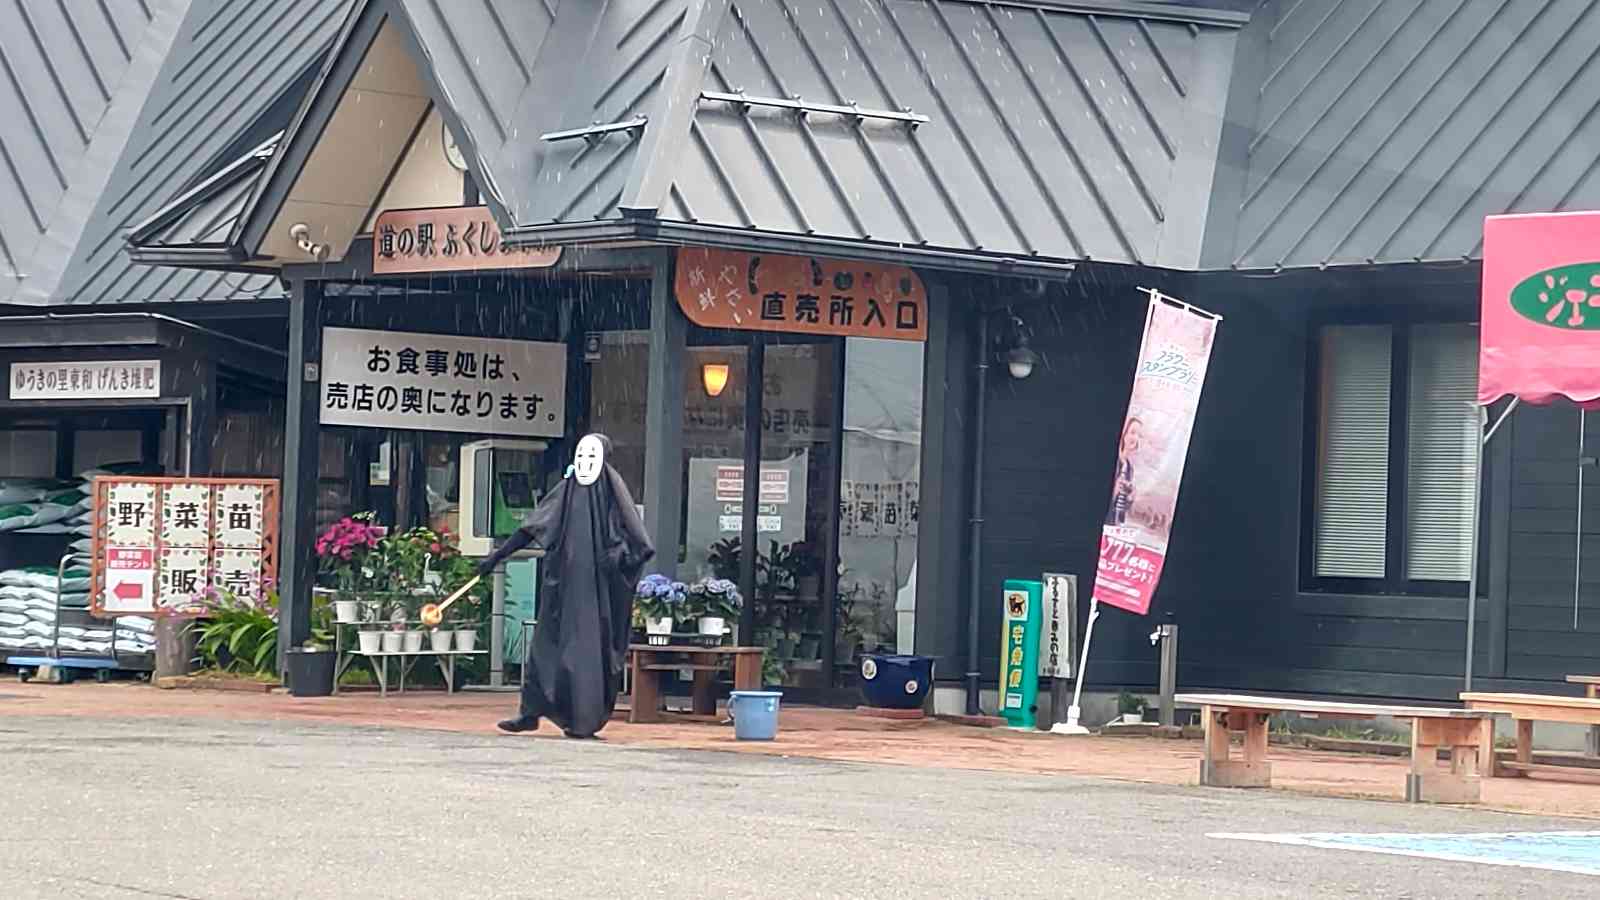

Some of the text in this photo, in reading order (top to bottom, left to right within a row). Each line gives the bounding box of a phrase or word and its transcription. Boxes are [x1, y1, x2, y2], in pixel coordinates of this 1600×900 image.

[378, 222, 436, 258] 道の駅
[760, 291, 919, 329] 直売所入口
[15, 367, 154, 391] ゆうきの里東和 げんき堆肥
[368, 345, 521, 382] お食事処は、
[326, 382, 556, 422] 売店の奥になります。
